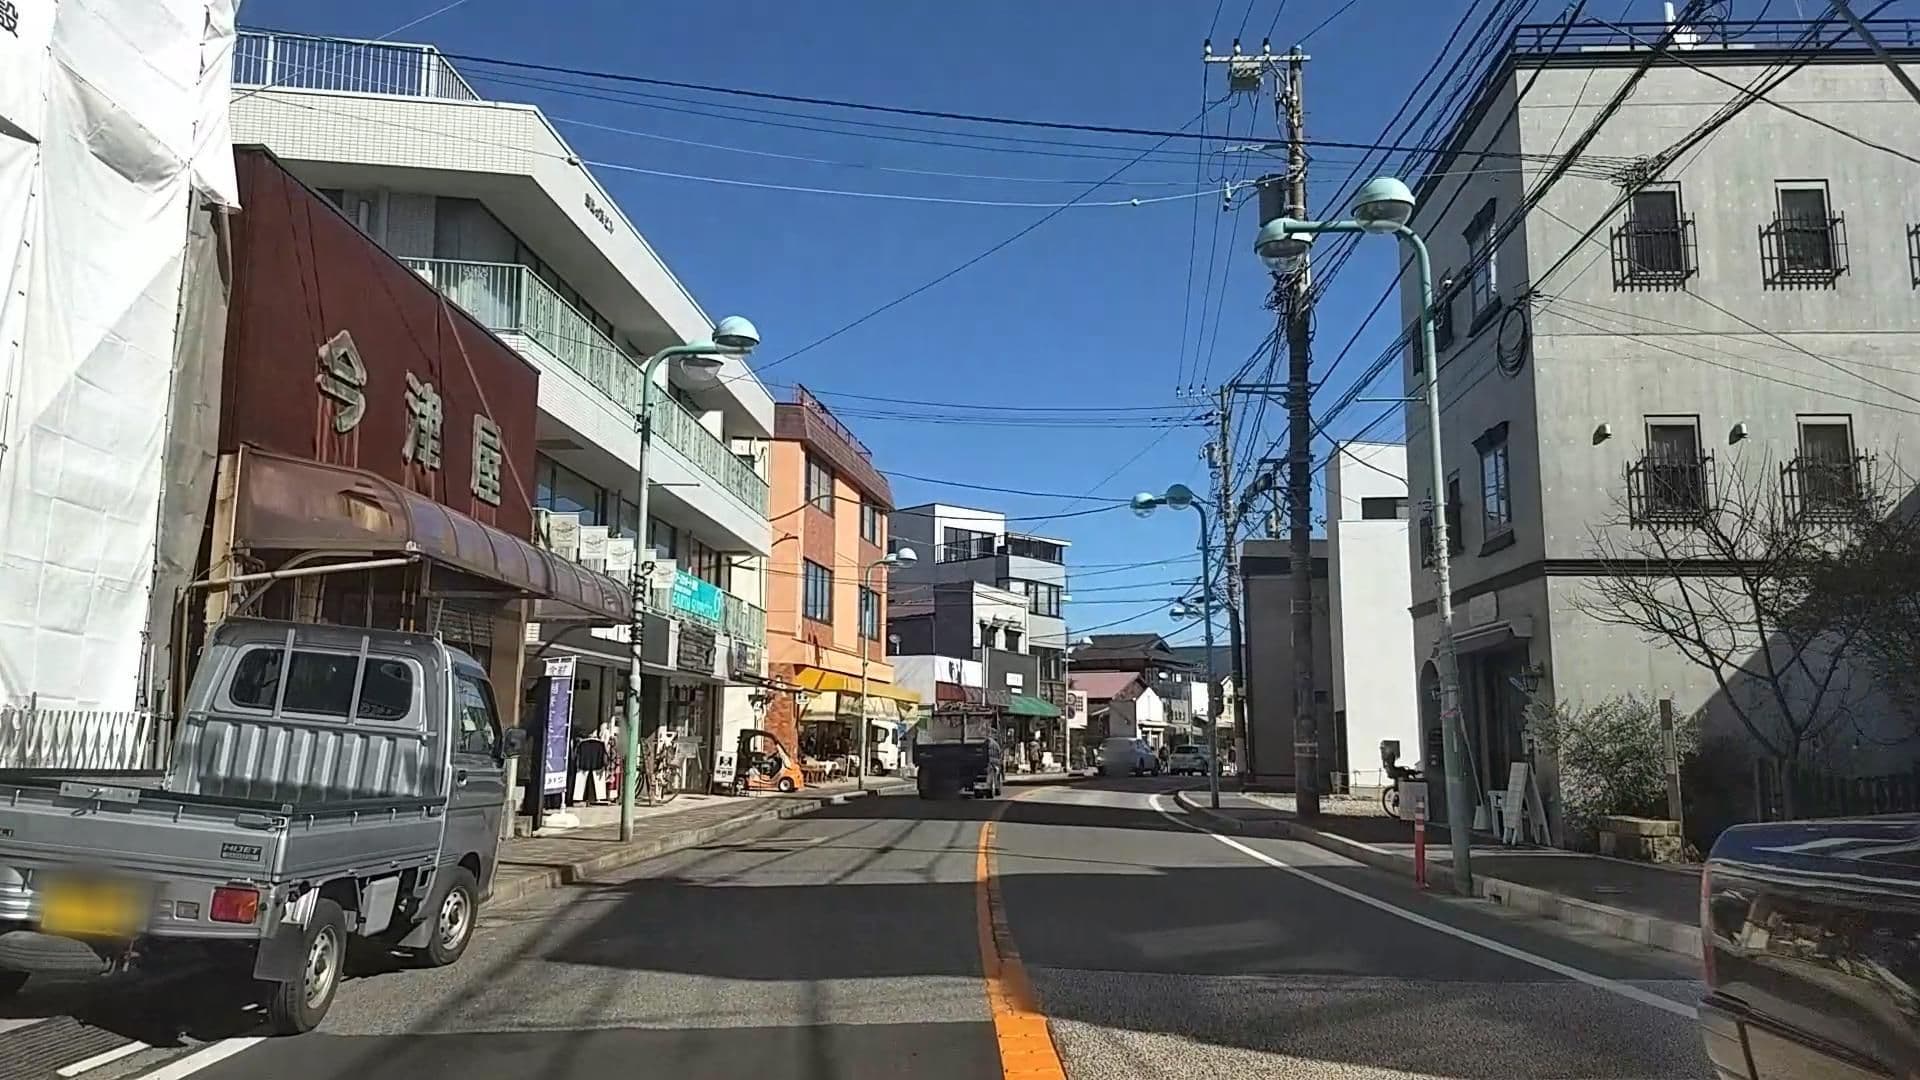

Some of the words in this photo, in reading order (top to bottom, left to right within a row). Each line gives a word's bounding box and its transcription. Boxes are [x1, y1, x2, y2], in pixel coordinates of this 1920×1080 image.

[315, 329, 502, 507] 今津屋
[223, 844, 261, 854] HIJET
